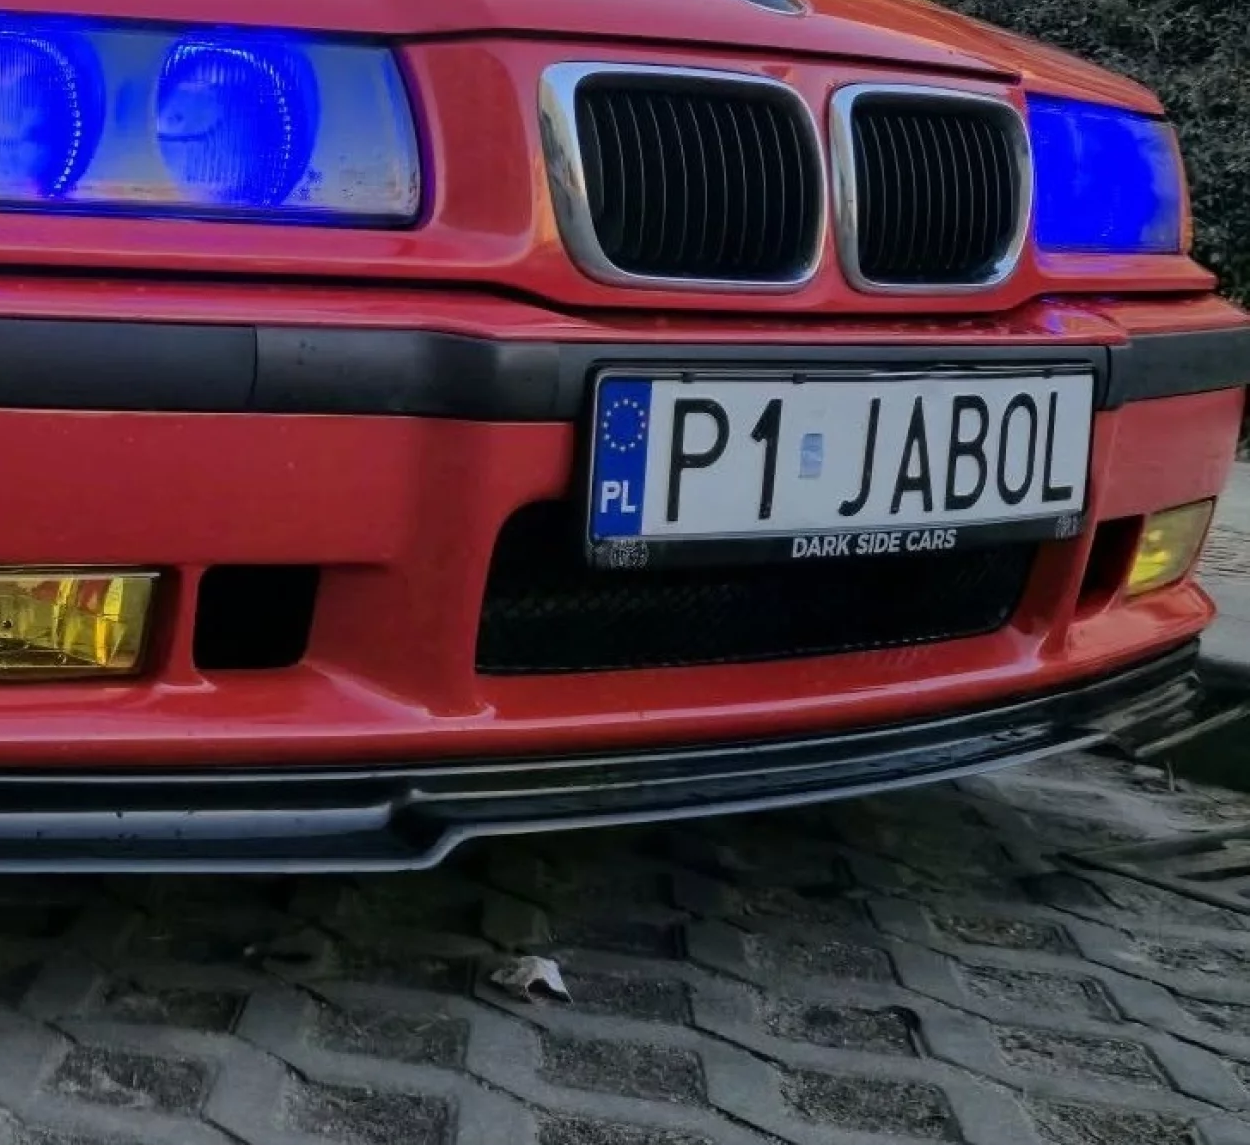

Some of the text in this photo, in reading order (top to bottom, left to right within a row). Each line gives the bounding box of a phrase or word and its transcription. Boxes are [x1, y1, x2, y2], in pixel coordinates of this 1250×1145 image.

[666, 392, 1072, 522] P1 JABOL
[600, 480, 636, 513] PL
[792, 529, 956, 558] DARK SIDE CARS
